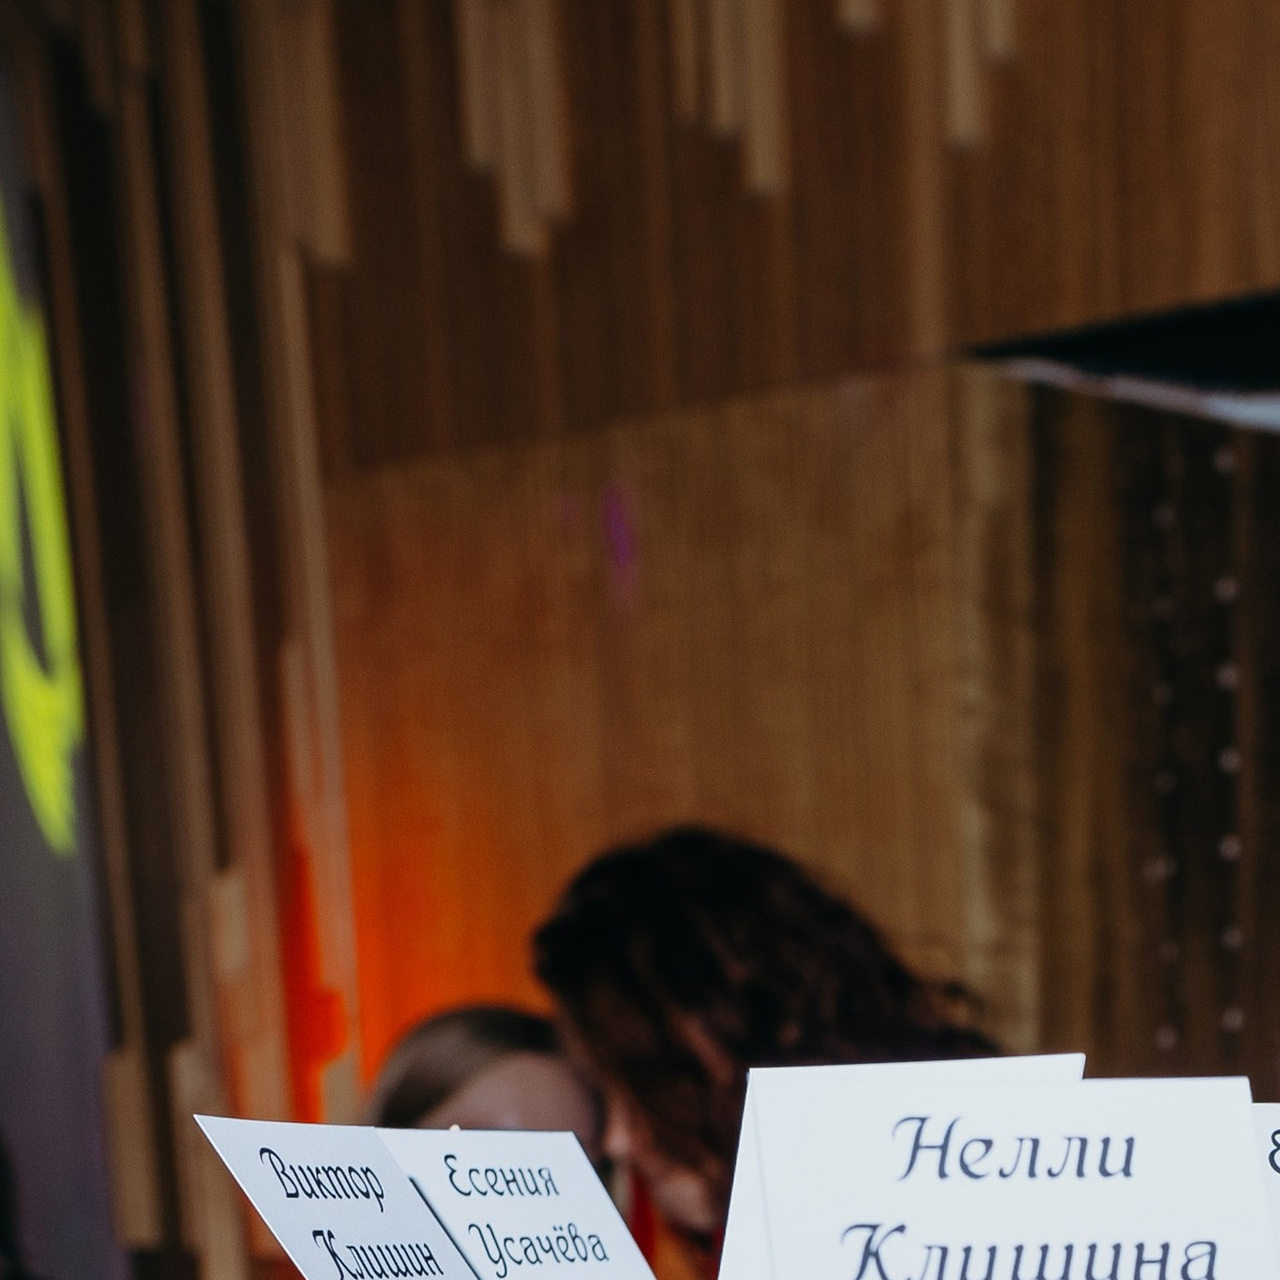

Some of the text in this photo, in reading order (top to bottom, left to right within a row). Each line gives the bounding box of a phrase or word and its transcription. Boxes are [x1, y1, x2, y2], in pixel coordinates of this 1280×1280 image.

[443, 1153, 561, 1199] Есения
[892, 1115, 1136, 1181] Нелли
[258, 1146, 386, 1213] Виктор
[467, 1222, 611, 1280] Усачёва
